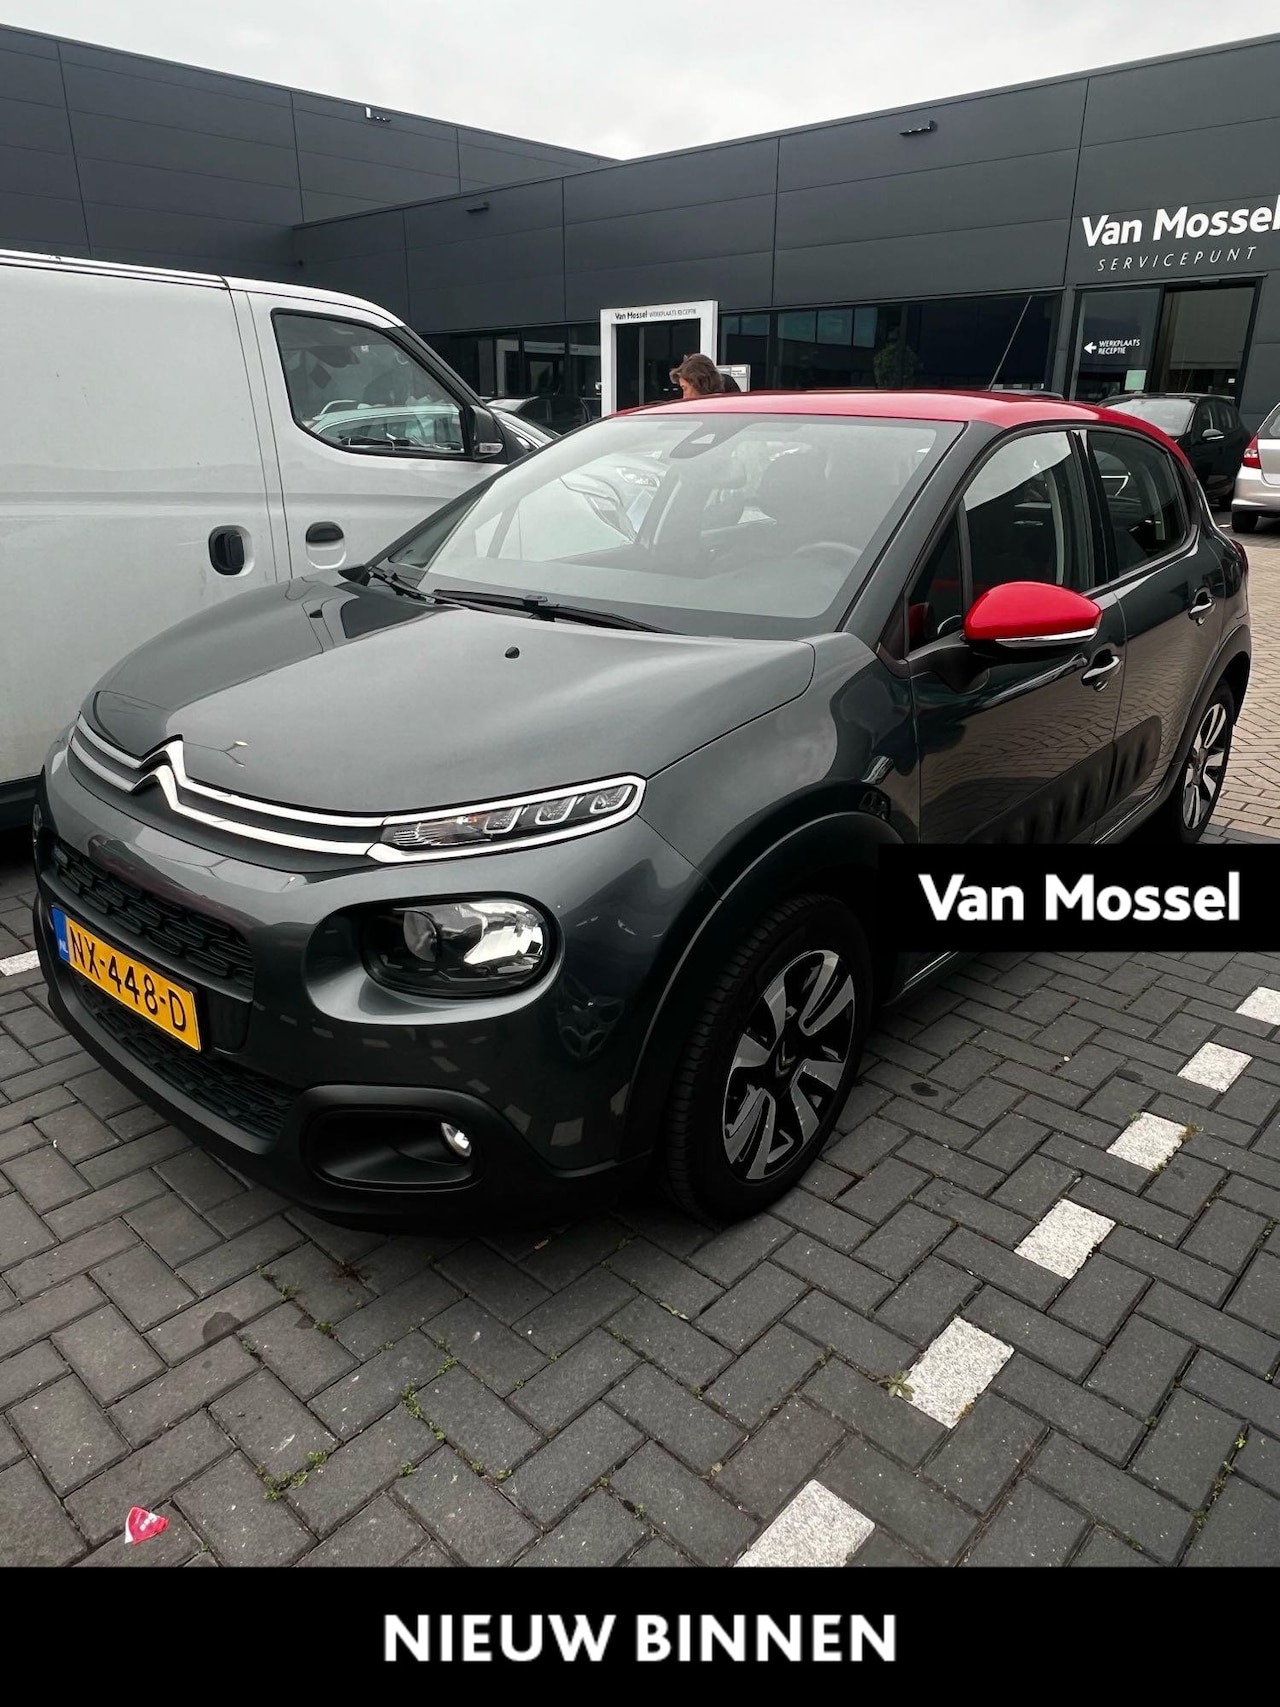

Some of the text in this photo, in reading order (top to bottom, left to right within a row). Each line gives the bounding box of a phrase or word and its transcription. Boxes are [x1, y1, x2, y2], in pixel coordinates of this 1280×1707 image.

[1082, 194, 1280, 247] Van Mossel
[1098, 246, 1256, 272] SERVICEPUNT
[615, 312, 626, 320] Van
[627, 310, 648, 319] Mossel
[1097, 346, 1127, 355] RECEPTIE
[1099, 338, 1141, 348] WERKPLAATS
[69, 926, 187, 1032] NX-448-D
